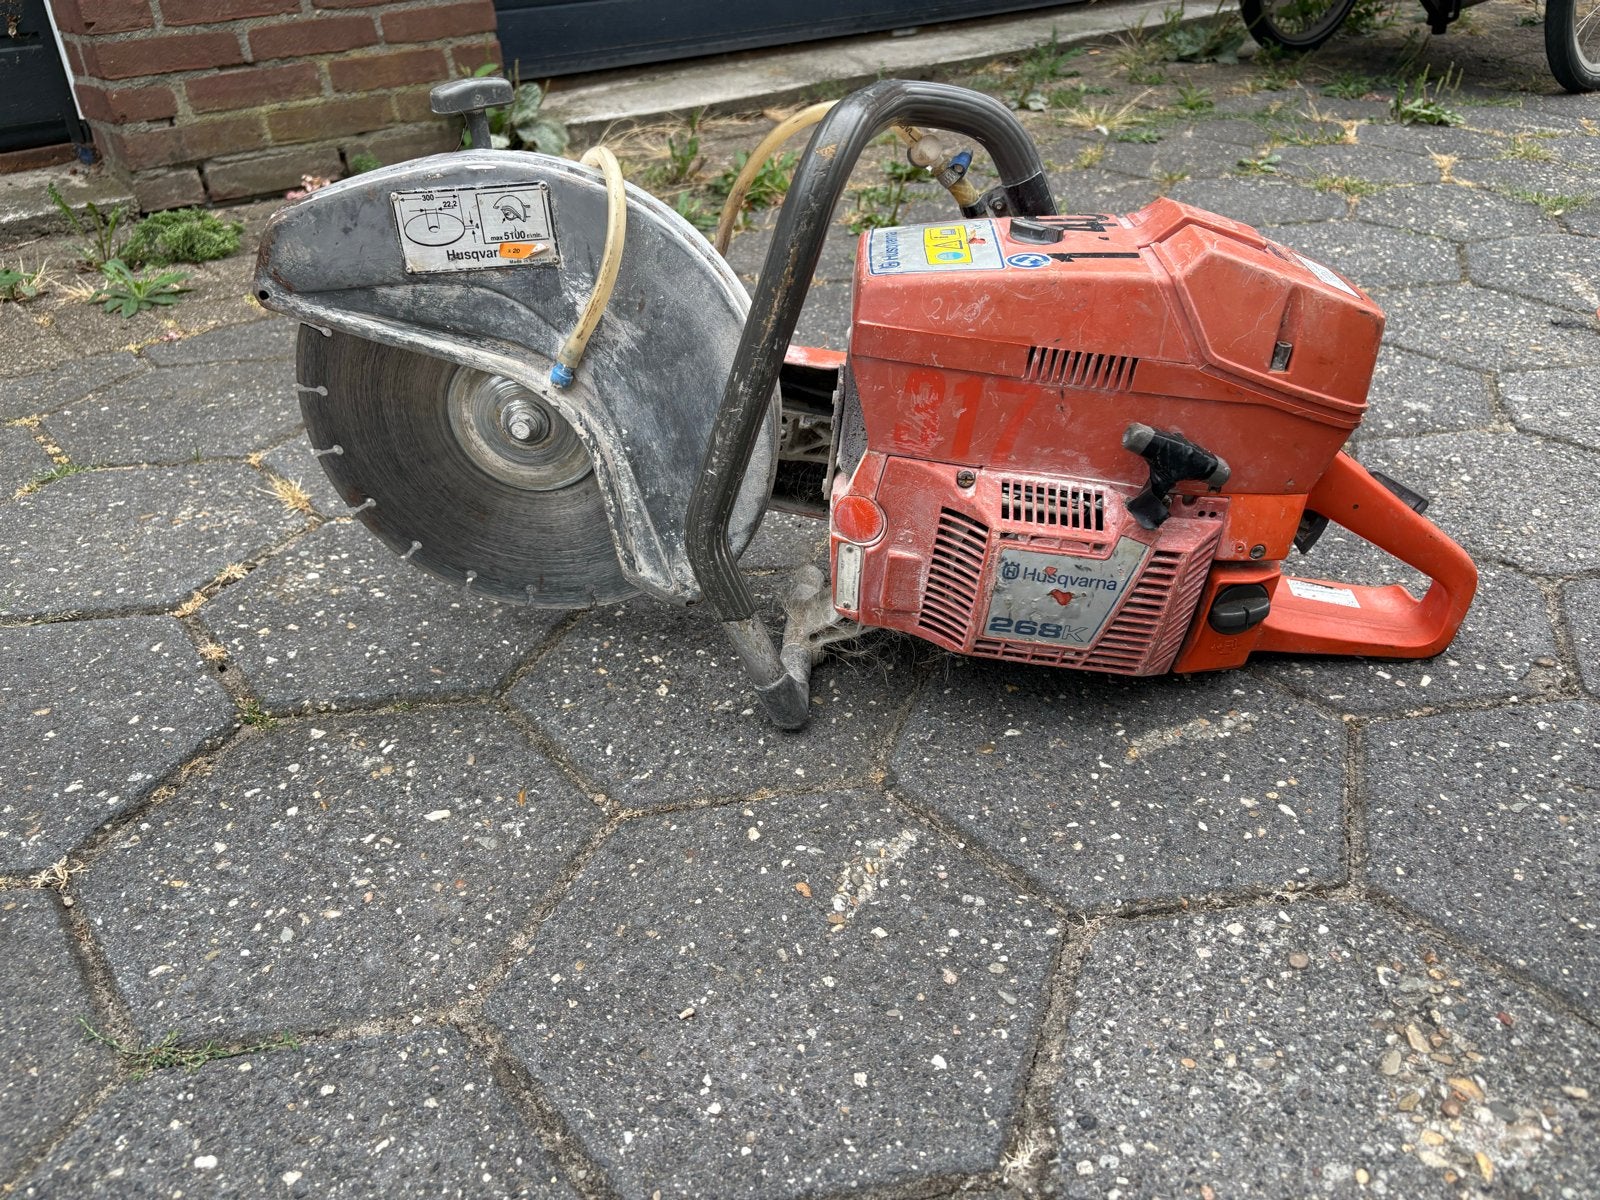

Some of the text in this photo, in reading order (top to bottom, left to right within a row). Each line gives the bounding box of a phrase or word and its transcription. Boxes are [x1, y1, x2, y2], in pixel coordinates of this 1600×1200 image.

[421, 194, 435, 202] 300
[442, 200, 458, 209] 22,2
[503, 230, 526, 241] 5100
[446, 248, 499, 263] Husqvar
[1023, 566, 1118, 591] Husqvarna
[988, 616, 1089, 643] 268K
